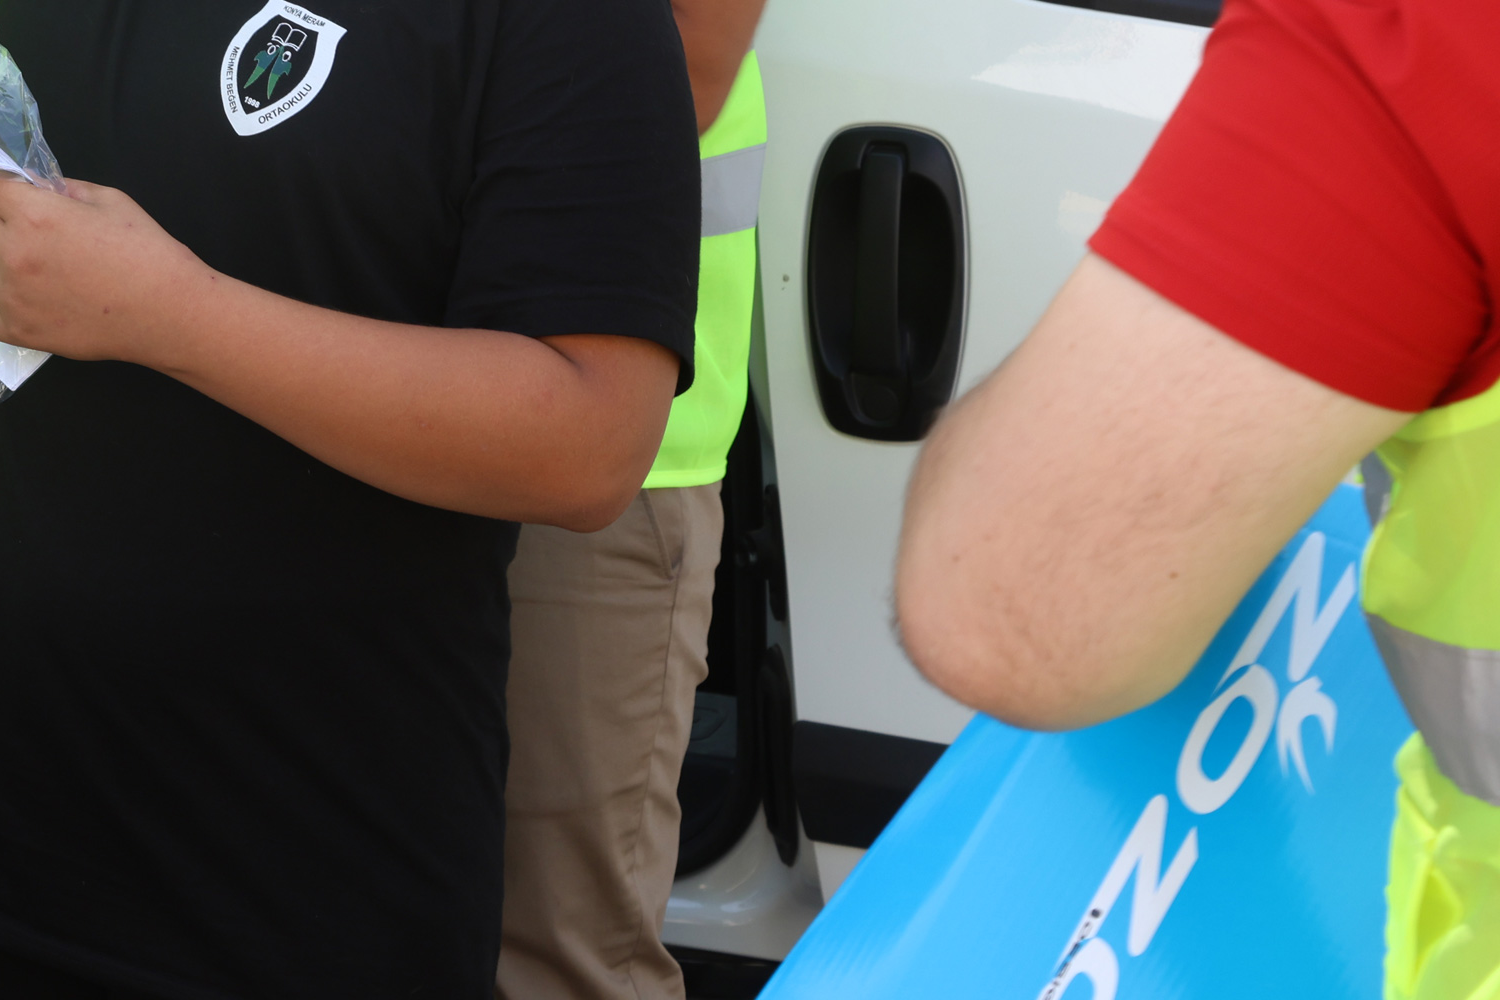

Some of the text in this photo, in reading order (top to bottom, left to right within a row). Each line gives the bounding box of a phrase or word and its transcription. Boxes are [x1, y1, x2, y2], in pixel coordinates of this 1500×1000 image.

[284, 5, 325, 27] KONYA MERAM
[226, 46, 240, 81] MEHMET
[258, 83, 313, 125] ORTAOKULU
